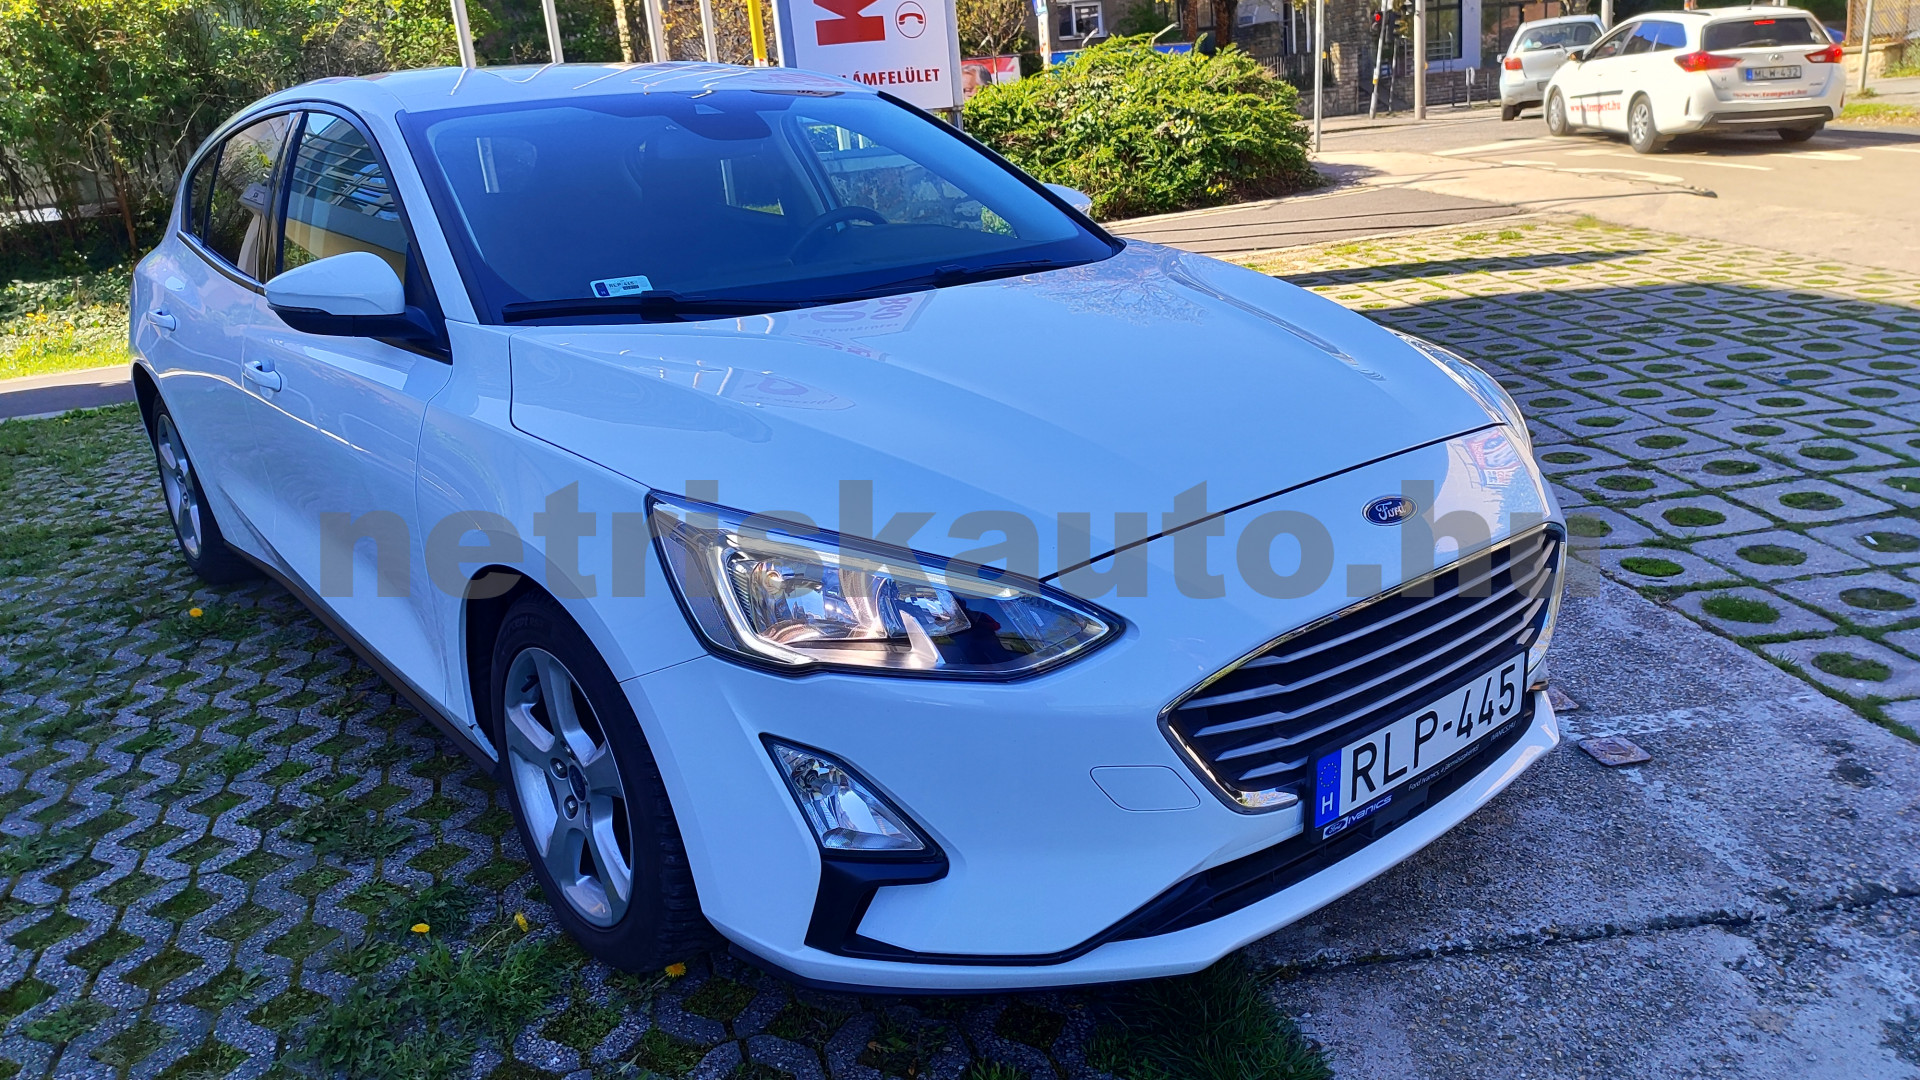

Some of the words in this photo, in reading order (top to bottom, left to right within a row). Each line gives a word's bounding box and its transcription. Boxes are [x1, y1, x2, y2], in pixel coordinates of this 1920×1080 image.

[838, 67, 940, 86] ÁMFELÜLET
[1375, 501, 1407, 520] Ford
[1350, 662, 1517, 804] RLP-445
[1321, 791, 1334, 815] H
